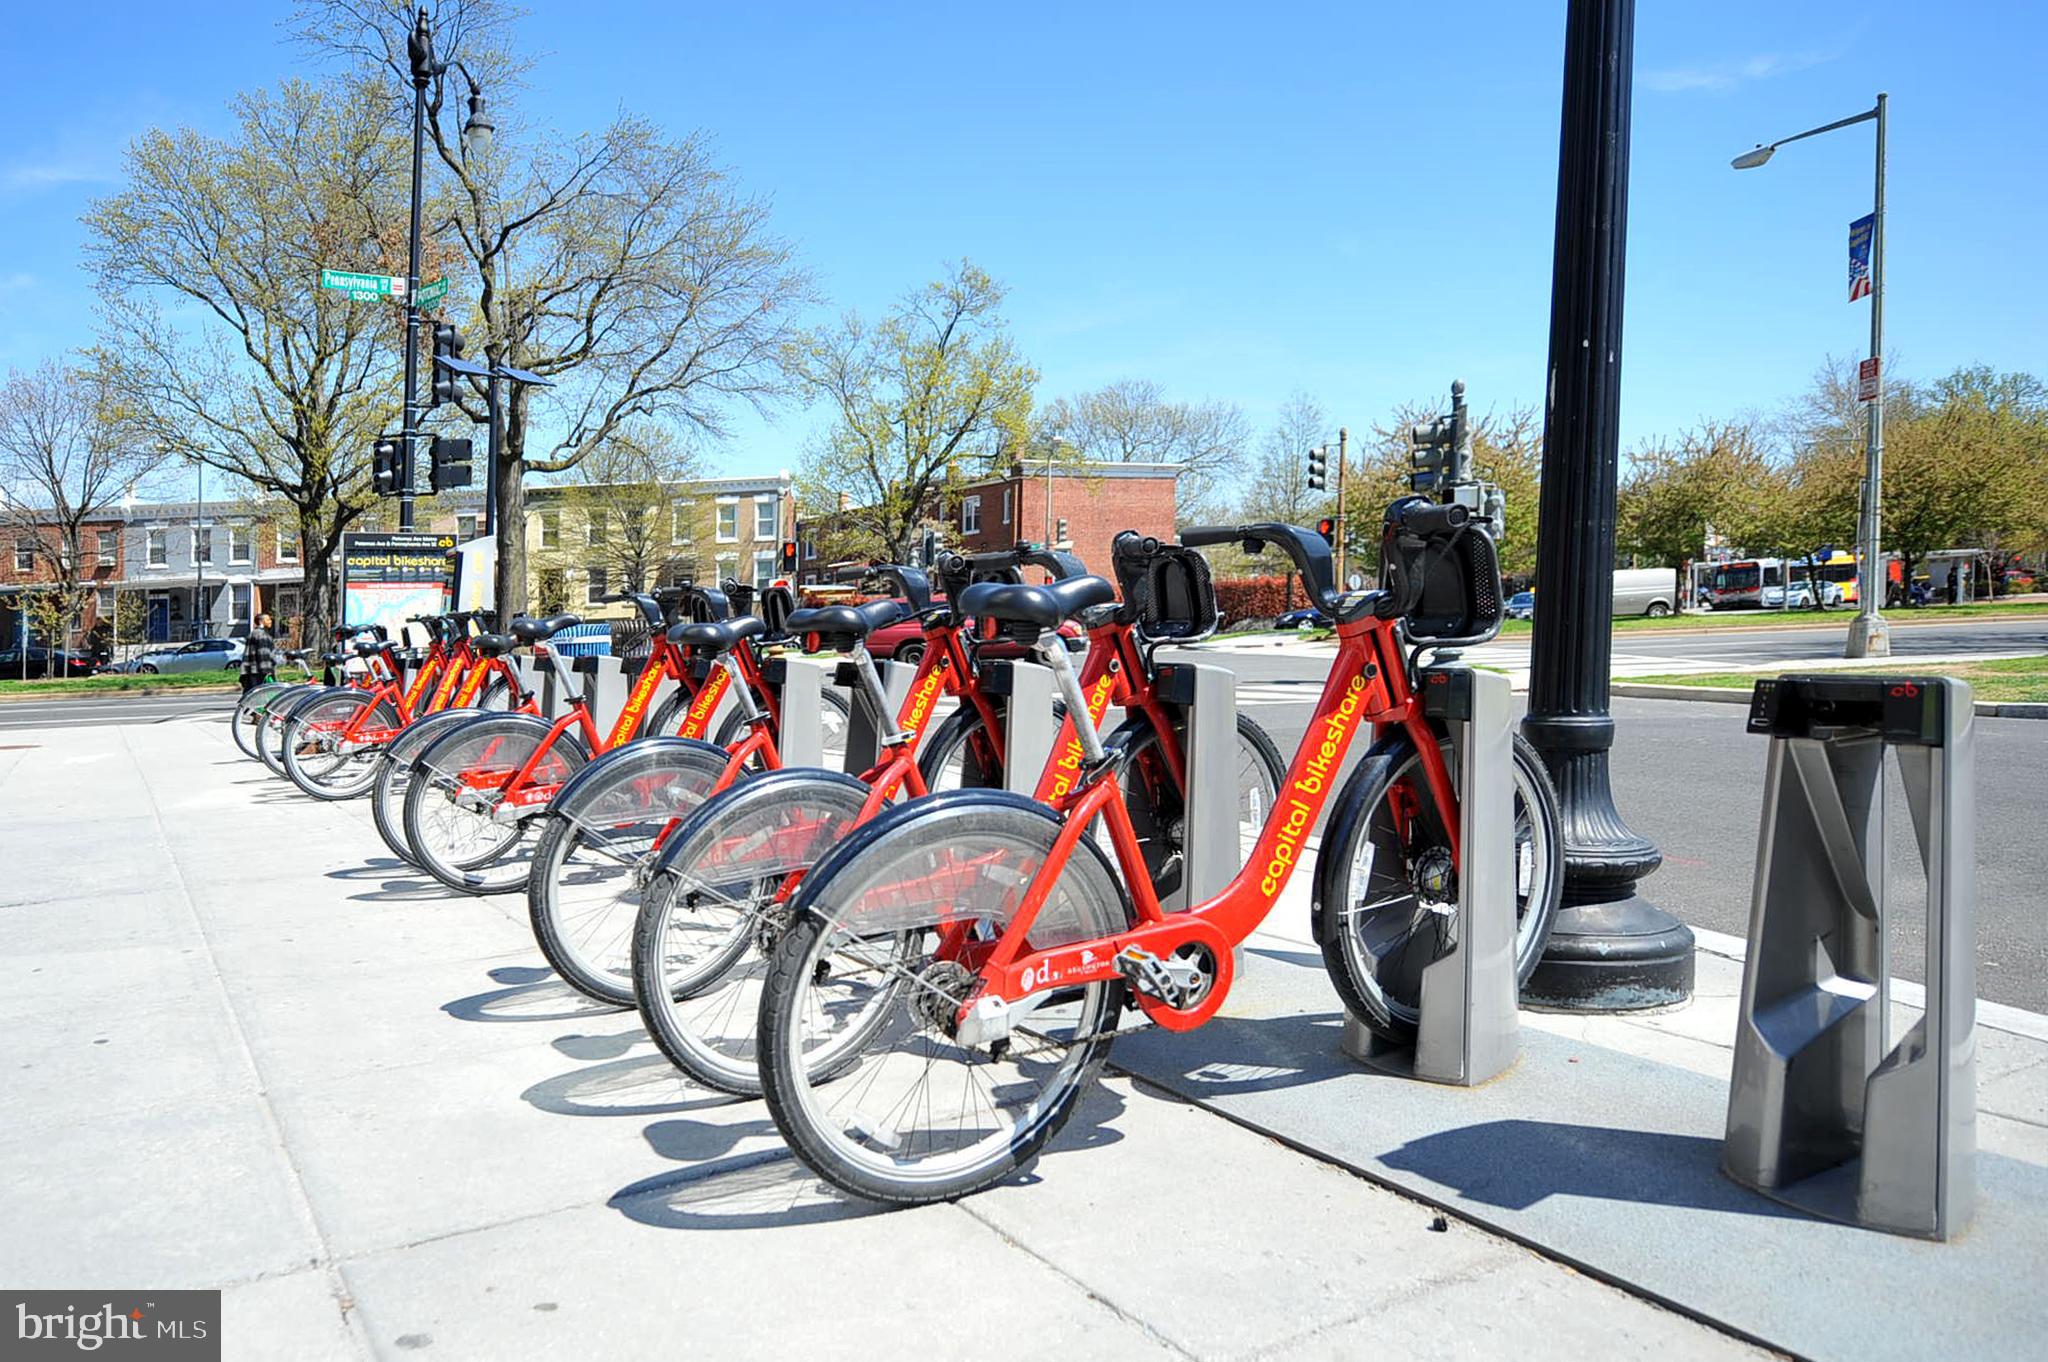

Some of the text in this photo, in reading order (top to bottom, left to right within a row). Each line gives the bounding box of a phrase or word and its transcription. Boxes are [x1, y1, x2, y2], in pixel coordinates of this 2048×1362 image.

[325, 271, 378, 291] Pennsylvania
[351, 291, 378, 301] 1300
[438, 536, 453, 547] cb
[347, 554, 447, 568] capital bikeshar
[613, 661, 662, 748] apital bikeshare
[690, 668, 728, 720] bikeshar
[902, 664, 942, 743] ikeshare
[1889, 681, 1920, 698] cb
[1057, 674, 1112, 769] bikhare
[1261, 674, 1366, 897] capital bikeshare
